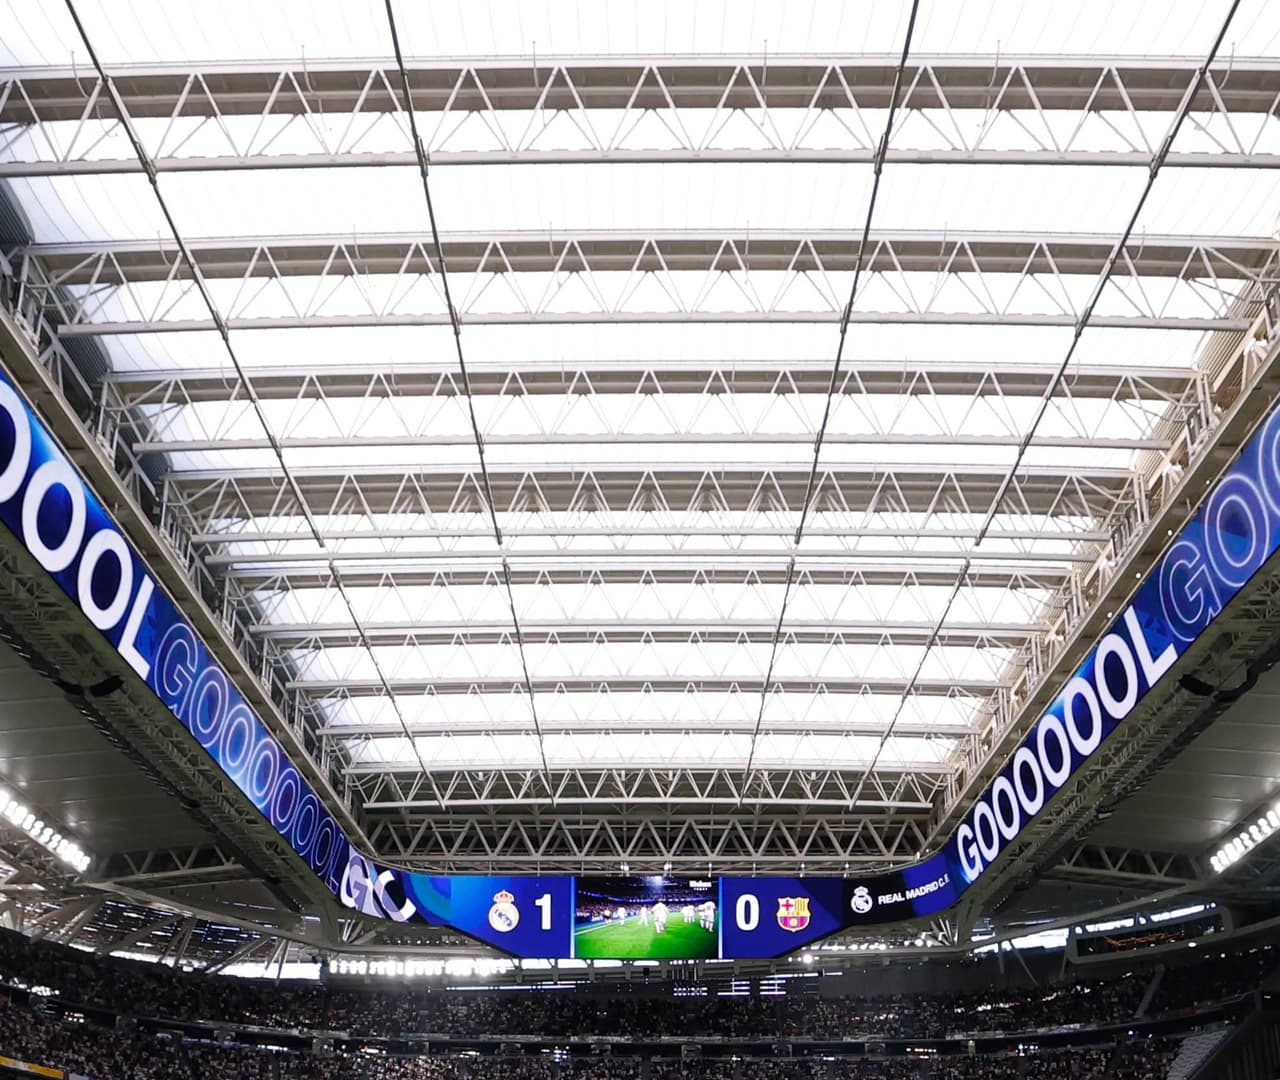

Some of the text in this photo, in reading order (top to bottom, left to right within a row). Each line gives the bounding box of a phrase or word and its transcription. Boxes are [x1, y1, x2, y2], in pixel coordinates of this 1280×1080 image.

[956, 604, 1178, 882] GOOOOOOL
[878, 892, 906, 905] REAL
[905, 881, 939, 900] MADRID
[534, 894, 553, 931] 1
[735, 894, 759, 931] 0
